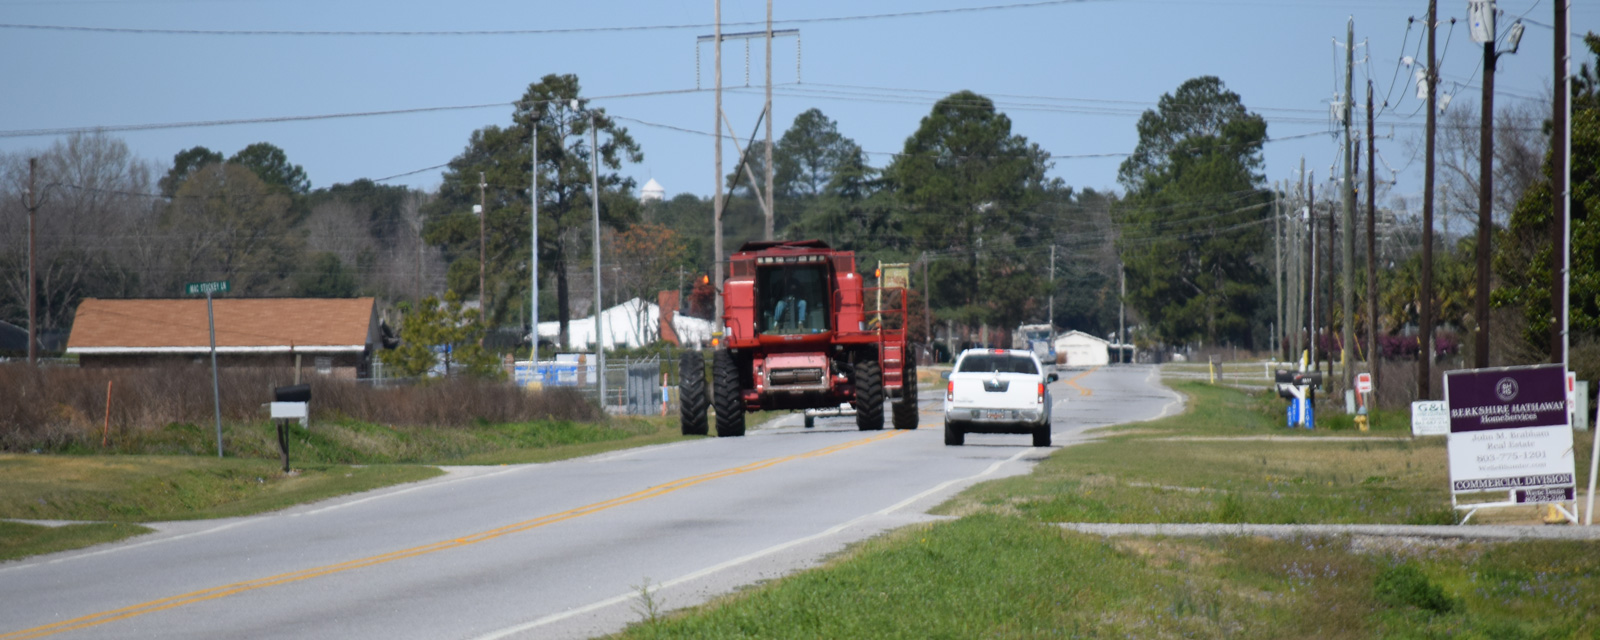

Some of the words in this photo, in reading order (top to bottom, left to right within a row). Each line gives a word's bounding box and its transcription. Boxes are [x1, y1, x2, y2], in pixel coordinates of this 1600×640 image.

[220, 281, 227, 290] LN
[1451, 404, 1509, 418] BERKSHIRE
[1511, 401, 1565, 414] HATHAWAY
[1480, 413, 1538, 425] HomeServices
[1472, 433, 1494, 442] John
[1496, 432, 1508, 440] M.
[1487, 441, 1506, 450] Real
[1509, 440, 1536, 448] Estate
[1476, 450, 1547, 463] 803-775-1201
[1456, 477, 1524, 489] COMMERCIAL
[1525, 474, 1570, 486] DIVISION
